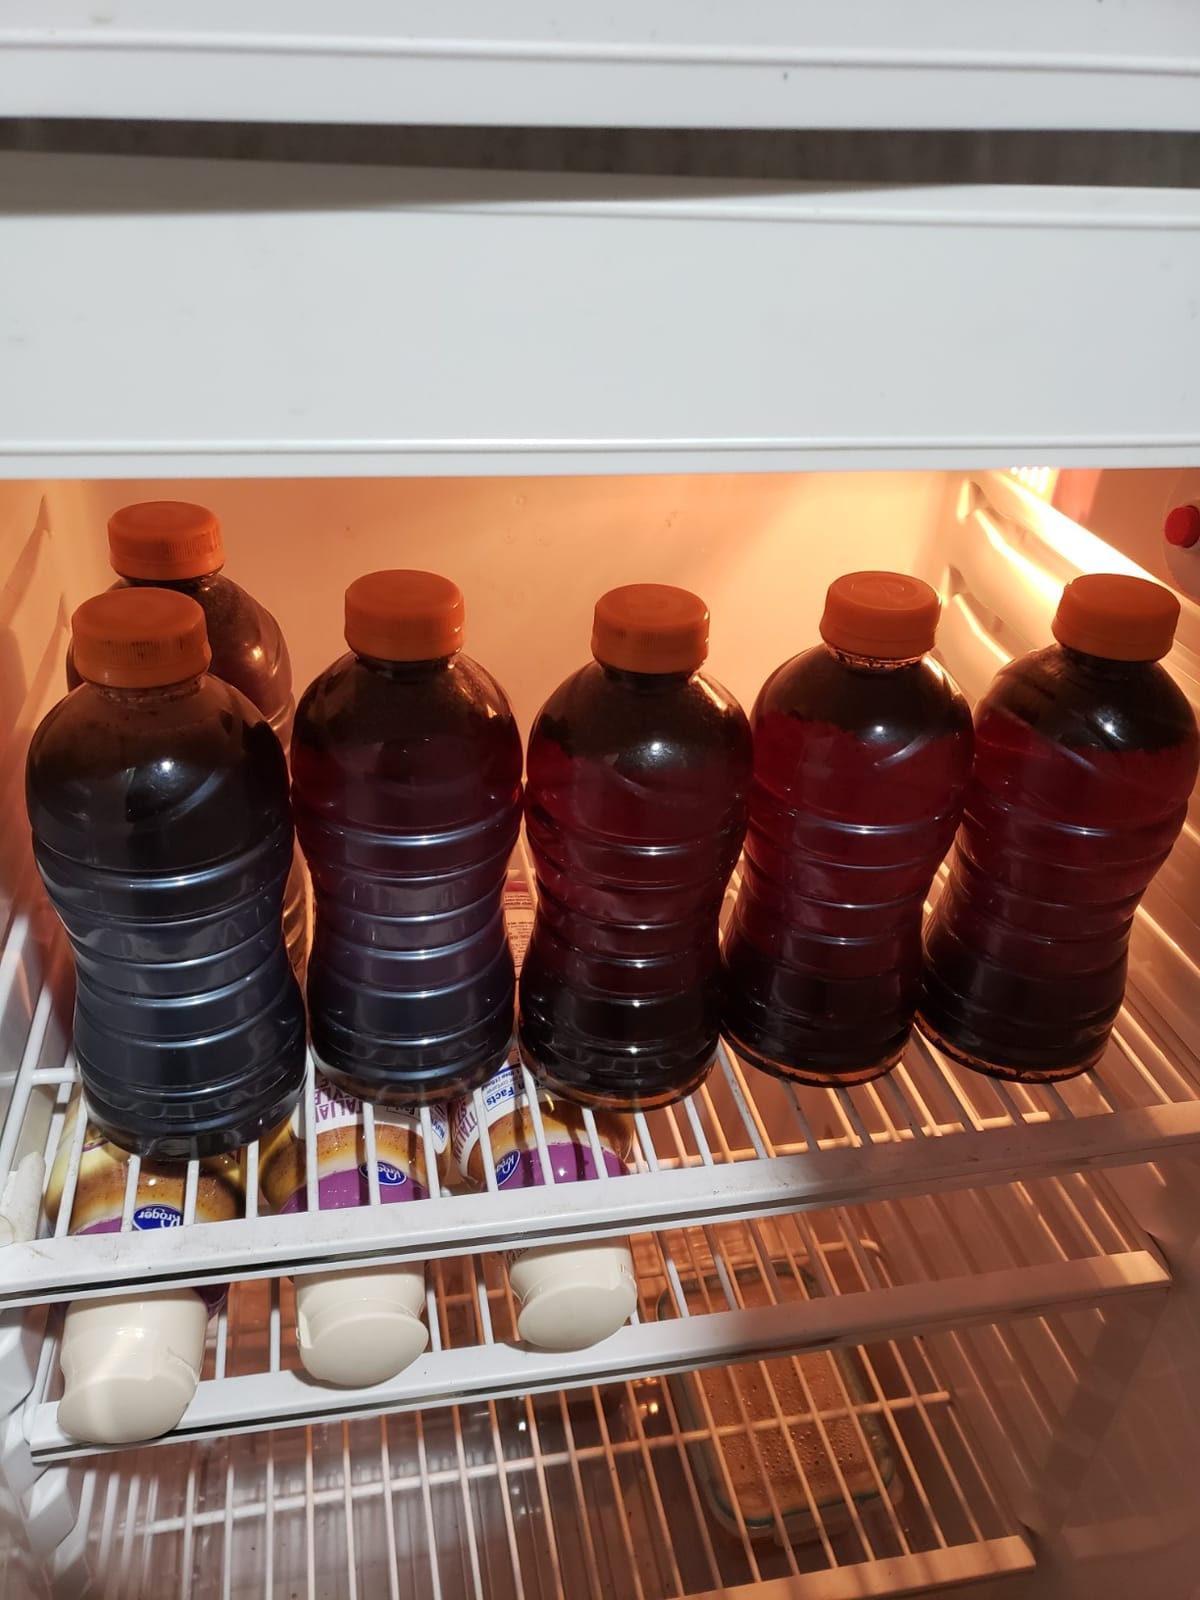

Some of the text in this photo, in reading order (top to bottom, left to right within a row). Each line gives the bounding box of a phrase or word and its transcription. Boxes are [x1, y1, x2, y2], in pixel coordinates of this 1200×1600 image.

[486, 1086, 515, 1106] Facts
[314, 1099, 363, 1123] TALIA
[137, 1208, 181, 1229] Kroger
